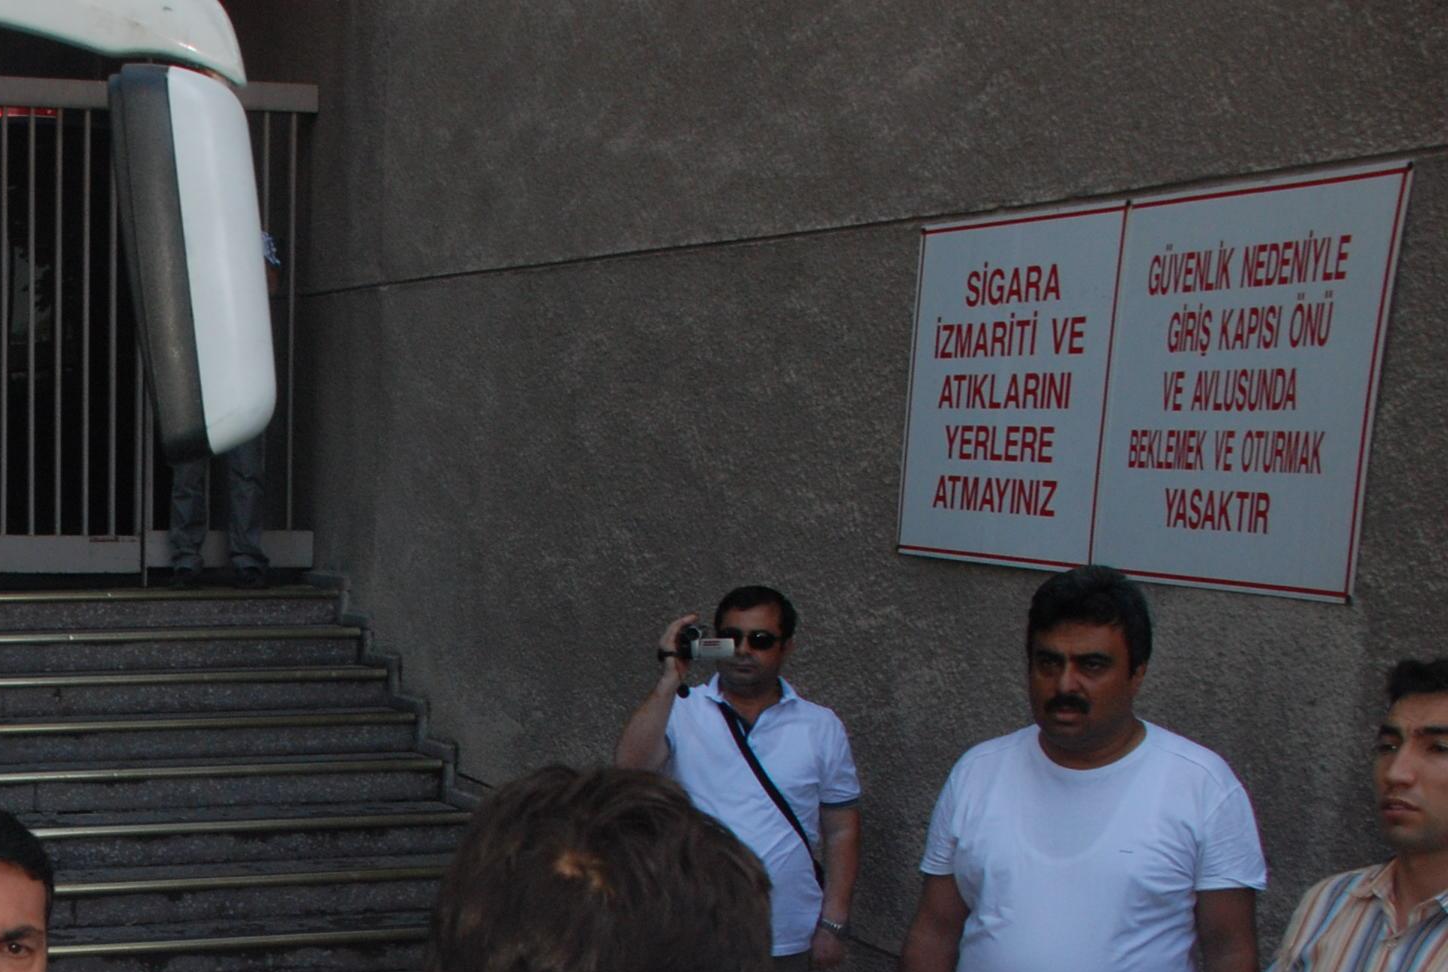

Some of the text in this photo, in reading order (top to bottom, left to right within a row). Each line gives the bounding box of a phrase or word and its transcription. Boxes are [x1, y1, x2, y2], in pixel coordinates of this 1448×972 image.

[966, 261, 1061, 307] SİGARA
[1148, 230, 1352, 296] GÜVENLİK NEDENİYLE
[934, 310, 1087, 359] İZMARİTİ VE
[1168, 290, 1334, 356] GİRİŞ KAPISI ÖNÜ
[938, 372, 1072, 409] ATIKLARINI
[1164, 367, 1297, 411] VE AVLUSUNDA
[945, 425, 1055, 463] YERLERE
[1128, 430, 1326, 474] BEKLEMEK VE OTURMAK
[932, 475, 1058, 517] ATMAYINIZ
[1165, 488, 1271, 534] YASAKTIR
